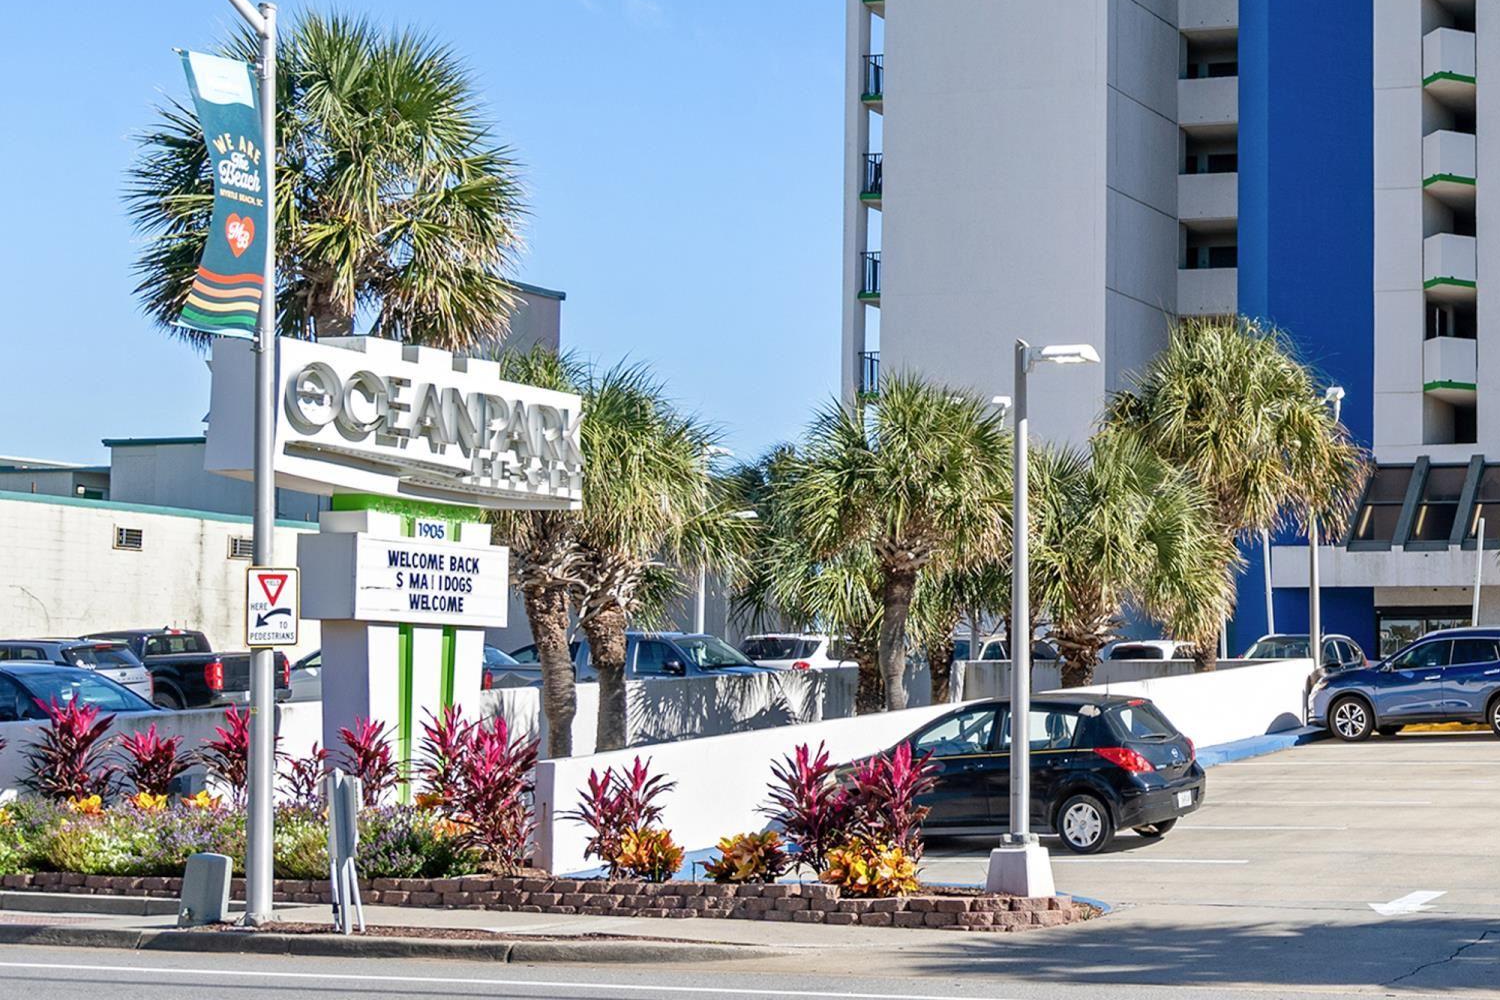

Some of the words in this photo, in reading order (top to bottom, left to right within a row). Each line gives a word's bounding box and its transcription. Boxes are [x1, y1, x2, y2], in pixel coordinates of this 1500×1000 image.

[212, 133, 235, 155] WE
[239, 135, 261, 166] ARE
[218, 159, 262, 192] Beach
[418, 522, 445, 539] 1905
[387, 549, 445, 571] WELCOME
[449, 556, 480, 574] BACK
[250, 602, 268, 611] HERE
[409, 593, 464, 613] WELCOME
[279, 621, 288, 630] TO
[250, 631, 295, 641] PEDESTRIANS
